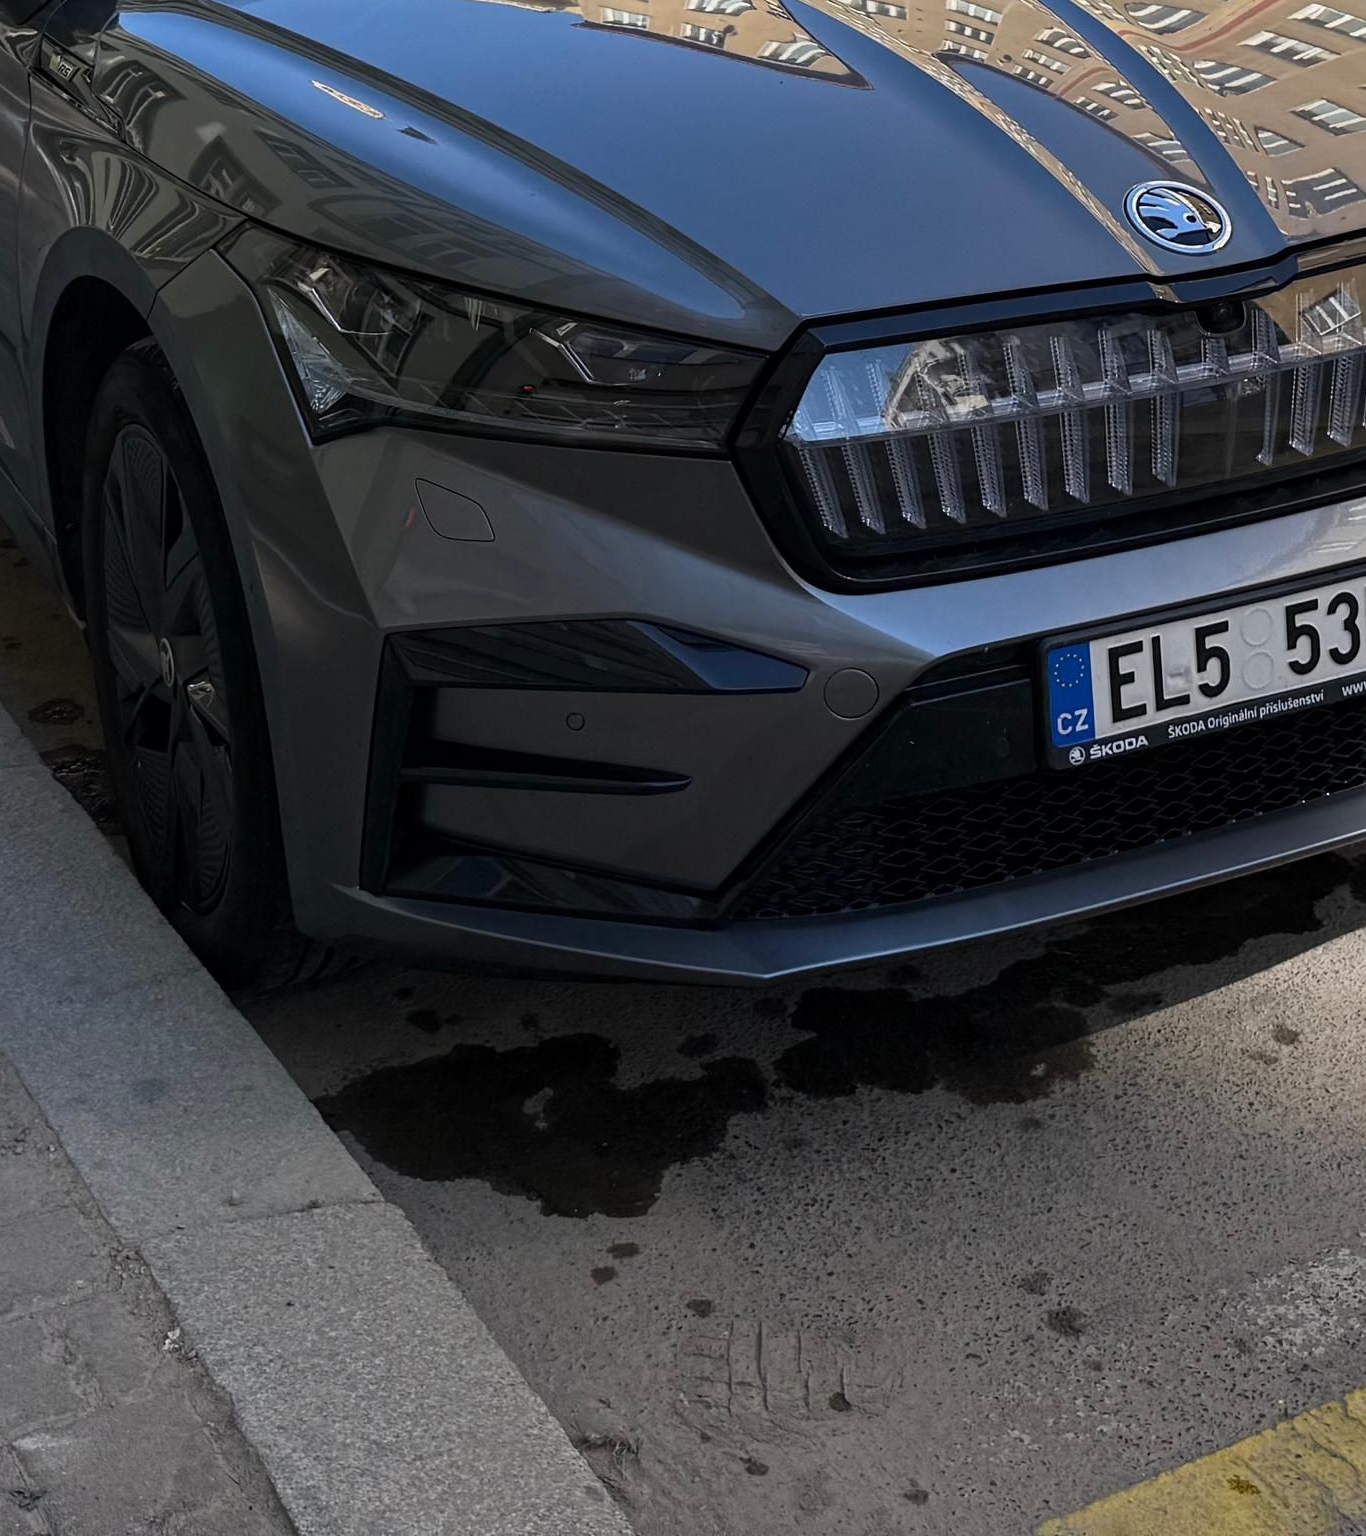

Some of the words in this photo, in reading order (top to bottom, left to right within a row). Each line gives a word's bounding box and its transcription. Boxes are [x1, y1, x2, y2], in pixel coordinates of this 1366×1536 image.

[1108, 621, 1231, 724] EL5
[1057, 708, 1089, 736] CZ
[1168, 719, 1206, 739] ŠKODA
[1207, 705, 1258, 729] Originální
[1259, 689, 1324, 719] příslušenství
[1089, 735, 1149, 760] ŠKODA
